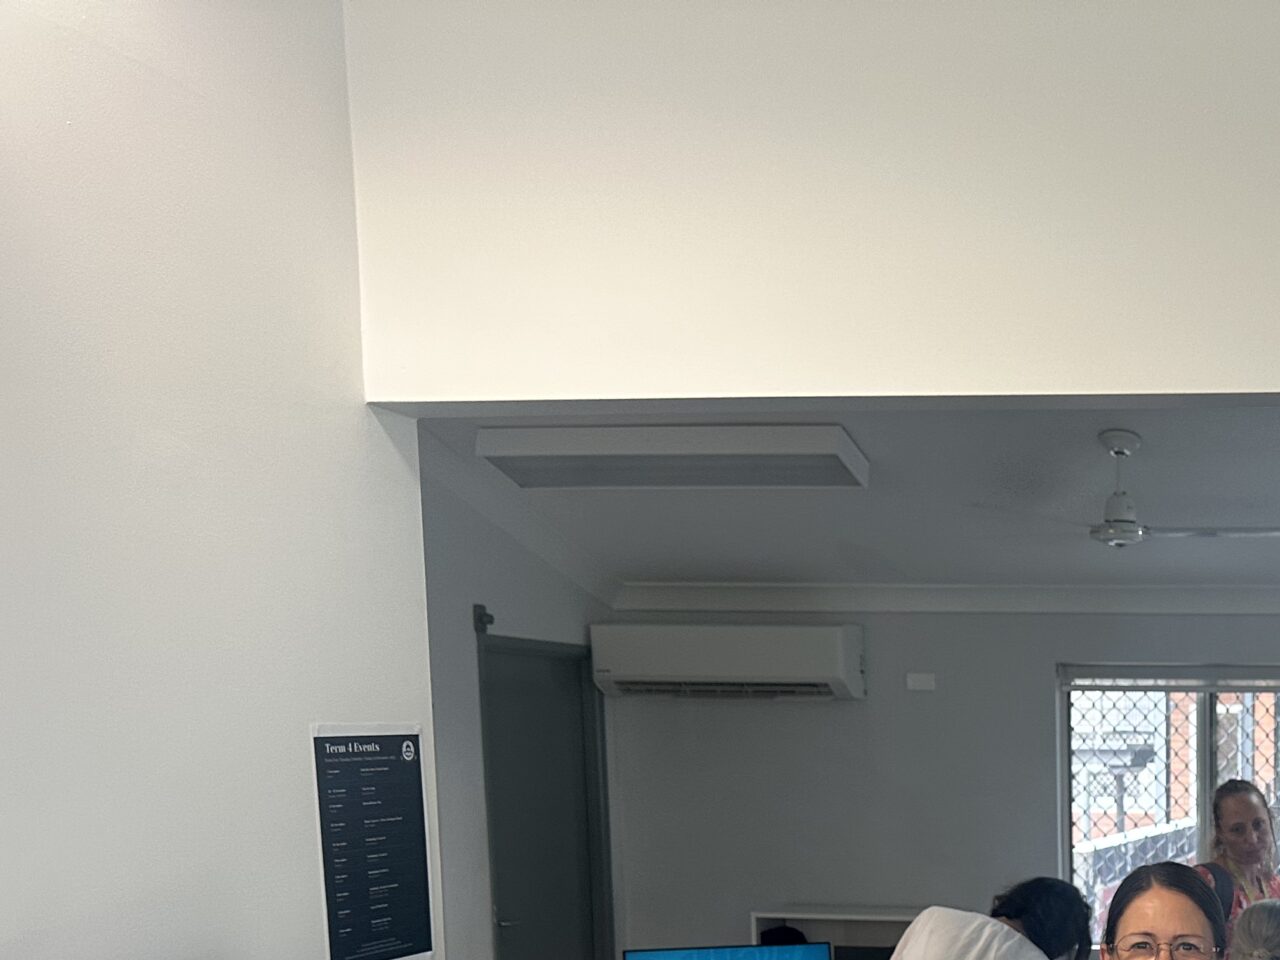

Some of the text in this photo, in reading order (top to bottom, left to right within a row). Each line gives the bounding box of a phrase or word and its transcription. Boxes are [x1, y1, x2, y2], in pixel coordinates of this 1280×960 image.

[325, 742, 380, 753] Term 4 Events
